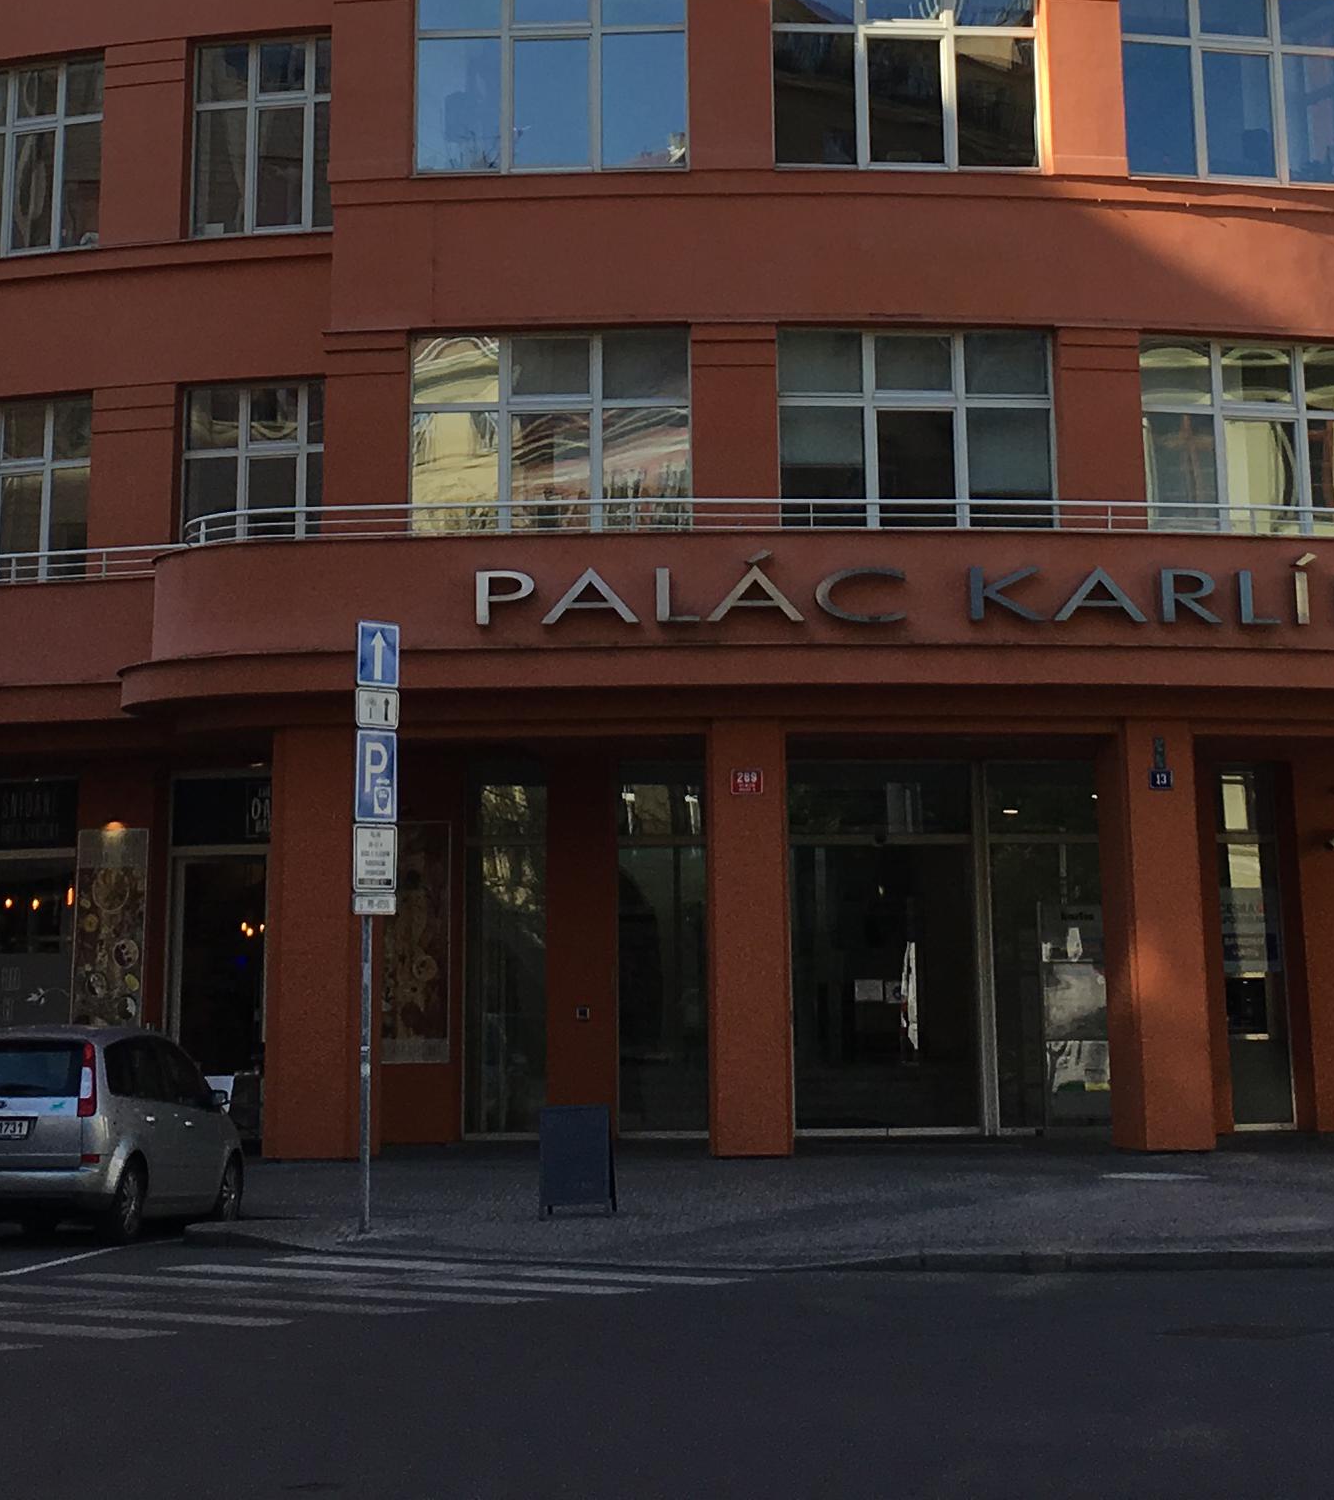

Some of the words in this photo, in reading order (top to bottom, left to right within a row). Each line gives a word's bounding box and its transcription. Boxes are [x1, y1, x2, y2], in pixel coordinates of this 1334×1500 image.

[475, 549, 907, 626] PALÁC
[364, 742, 388, 792] P
[1155, 772, 1168, 786] 13
